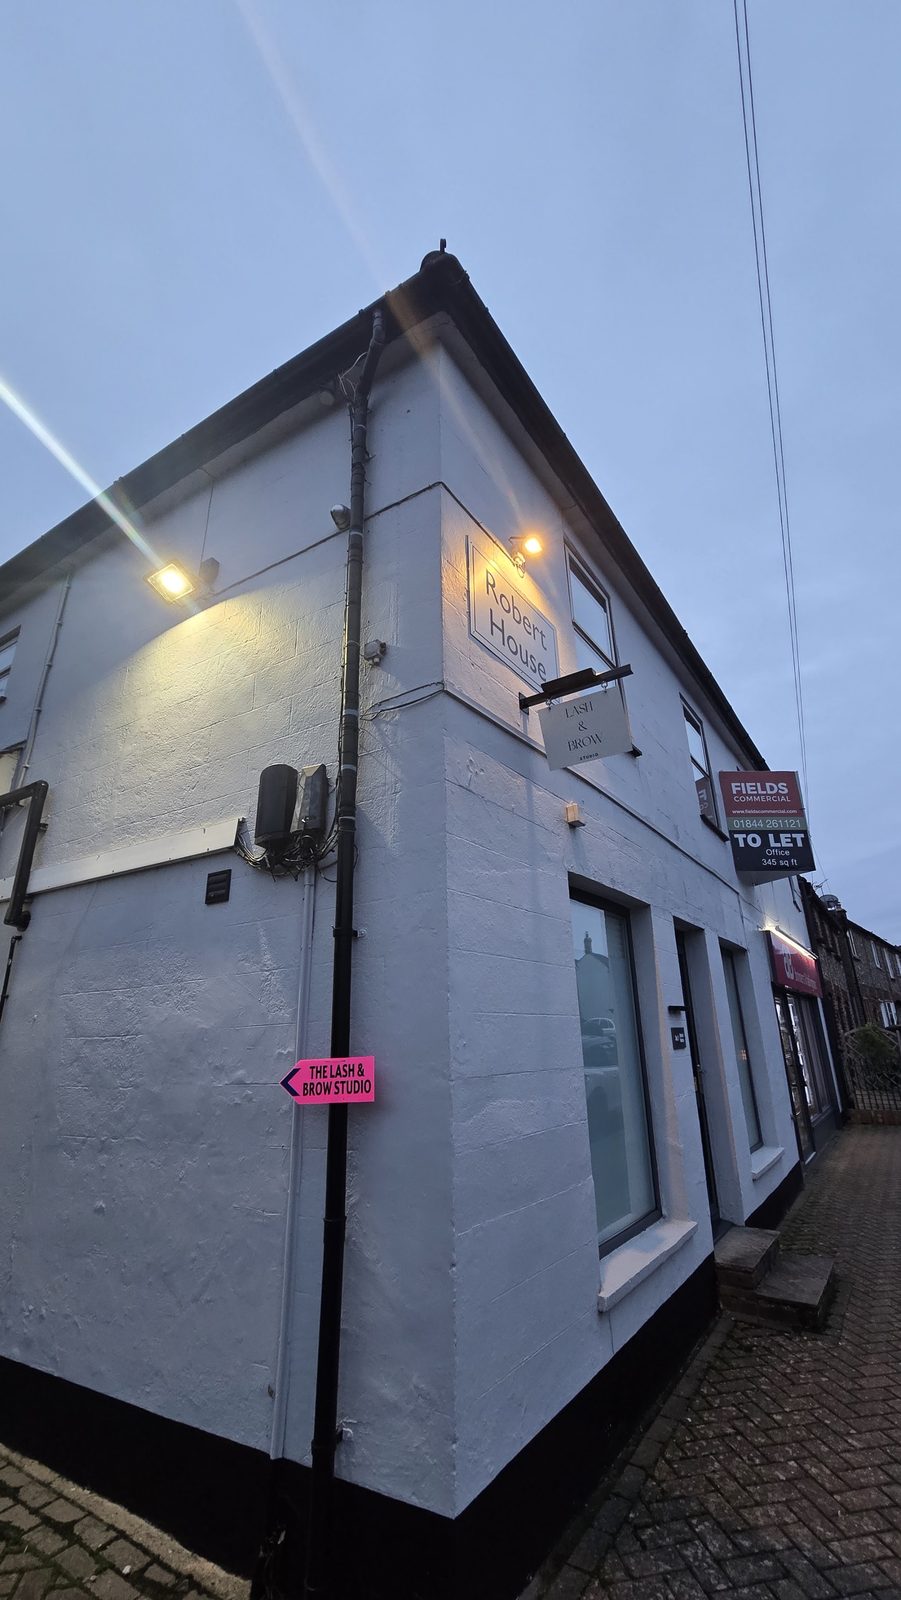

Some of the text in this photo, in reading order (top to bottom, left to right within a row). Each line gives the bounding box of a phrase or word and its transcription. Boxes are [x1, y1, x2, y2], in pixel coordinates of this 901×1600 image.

[487, 570, 547, 650] Robert
[490, 609, 547, 681] House
[566, 702, 593, 718] LASH
[579, 721, 587, 731] &
[568, 734, 601, 751] BROW
[732, 783, 788, 794] FIELDS
[734, 820, 800, 828] 01844 261121
[734, 834, 804, 847] TO LET
[310, 1063, 364, 1079] THE LASH &
[303, 1080, 371, 1095] BROW STUDIO
